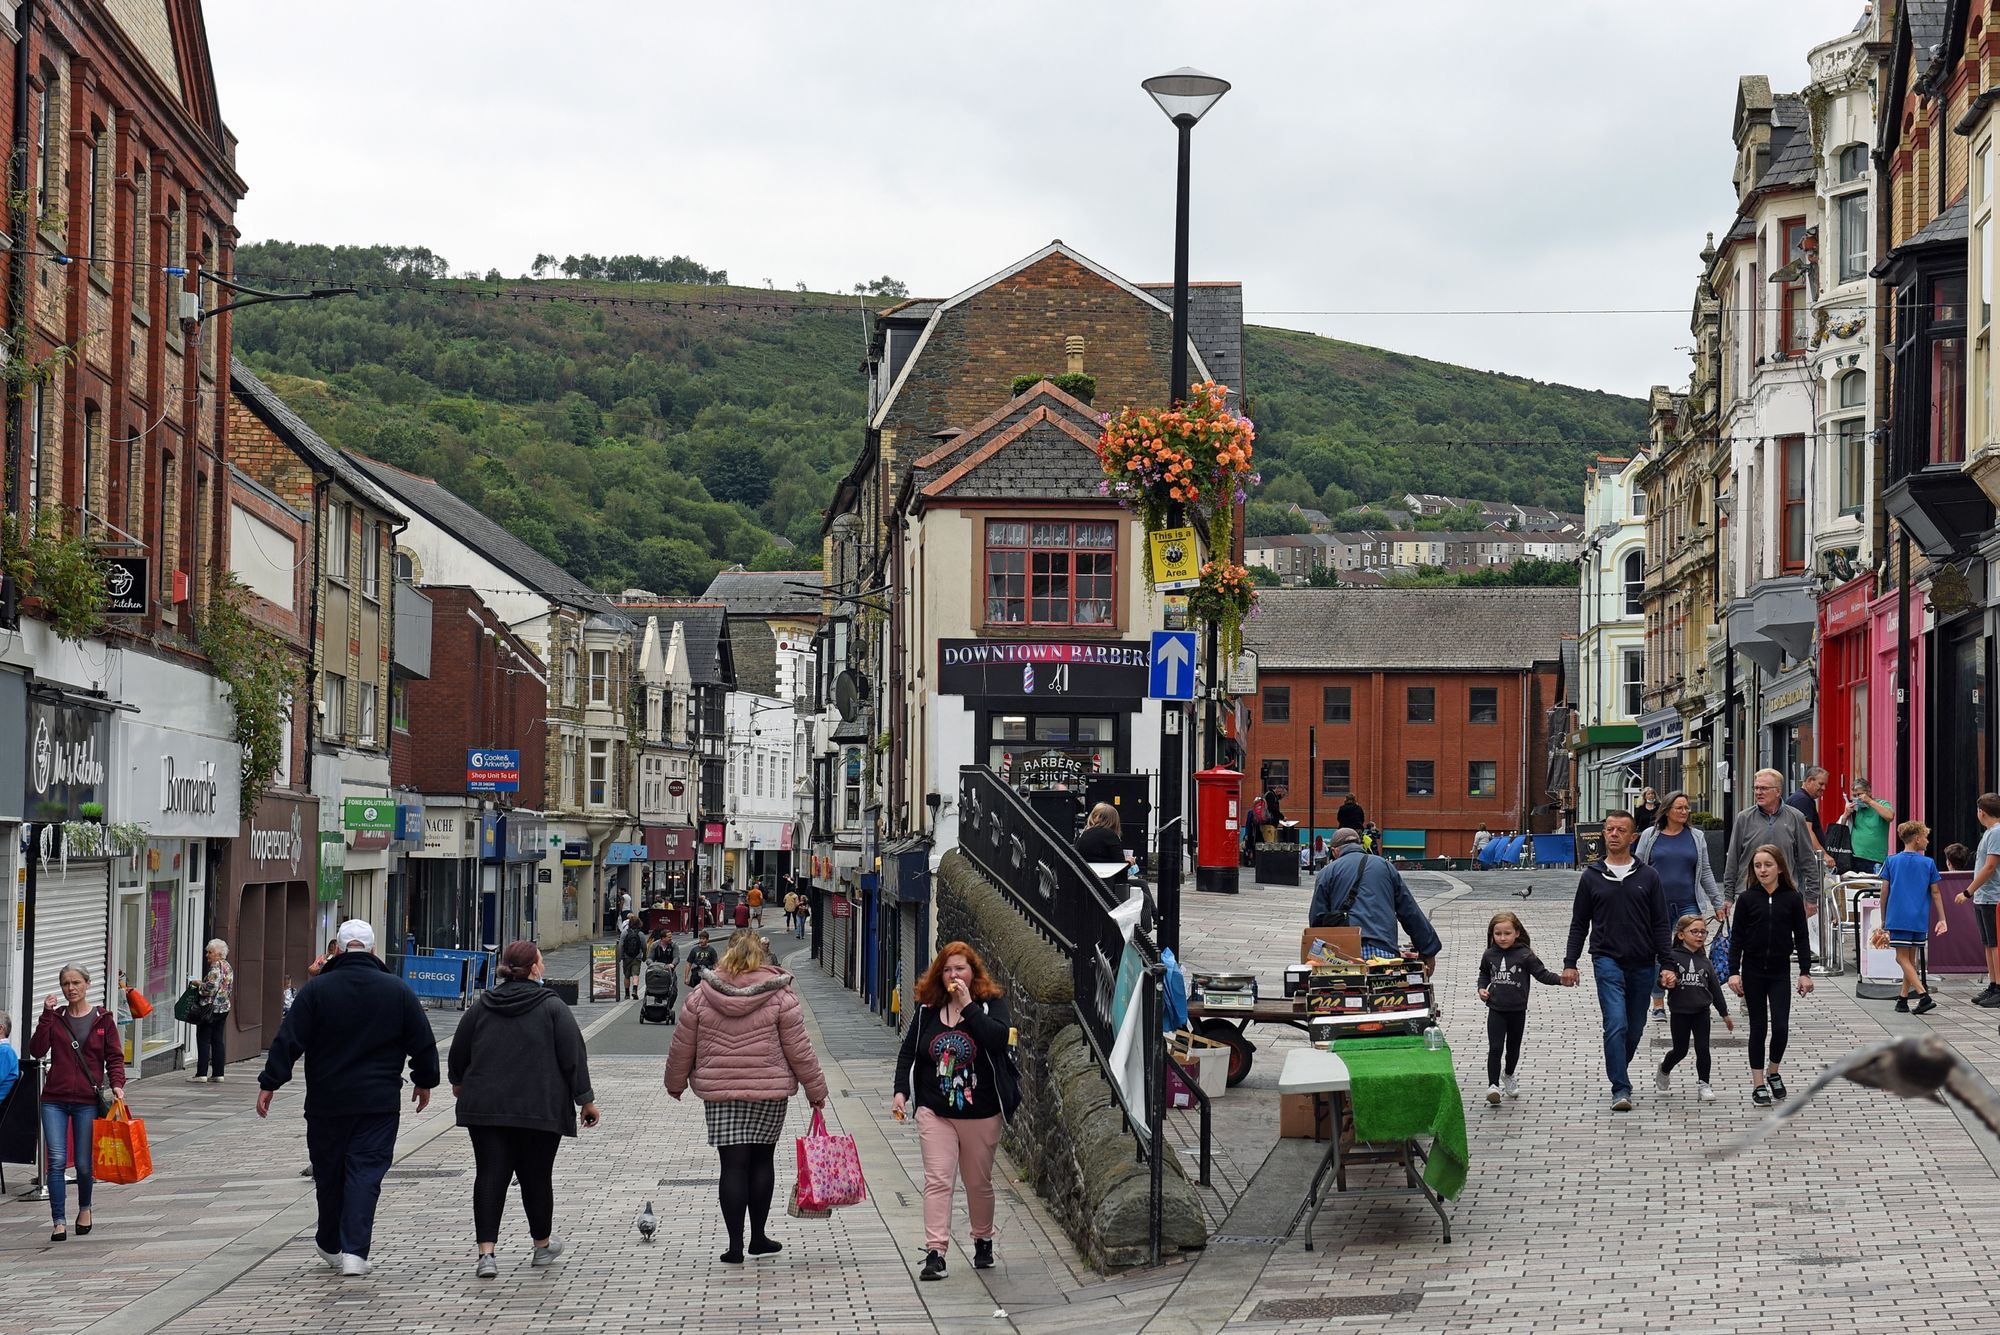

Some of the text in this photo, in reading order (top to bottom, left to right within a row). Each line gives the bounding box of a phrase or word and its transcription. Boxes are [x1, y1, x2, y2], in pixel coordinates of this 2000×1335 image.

[1153, 532, 1172, 541] This
[1175, 530, 1184, 538] is
[1166, 569, 1187, 578] Area
[113, 598, 142, 609] Kitchen
[945, 644, 1063, 665] DOWNTOWN
[1169, 712, 1175, 725] 1
[73, 735, 105, 787] Kitchen
[483, 761, 515, 769] Arkwright
[1024, 757, 1082, 772] BARBERS
[471, 772, 487, 780] Shop
[162, 755, 217, 814] Bonmarché
[250, 818, 290, 871] hoperescue
[593, 949, 616, 957] LUNCH
[418, 972, 456, 982] GREGGS
[1494, 971, 1511, 981] LOVE
[1682, 973, 1700, 982] LOVE
